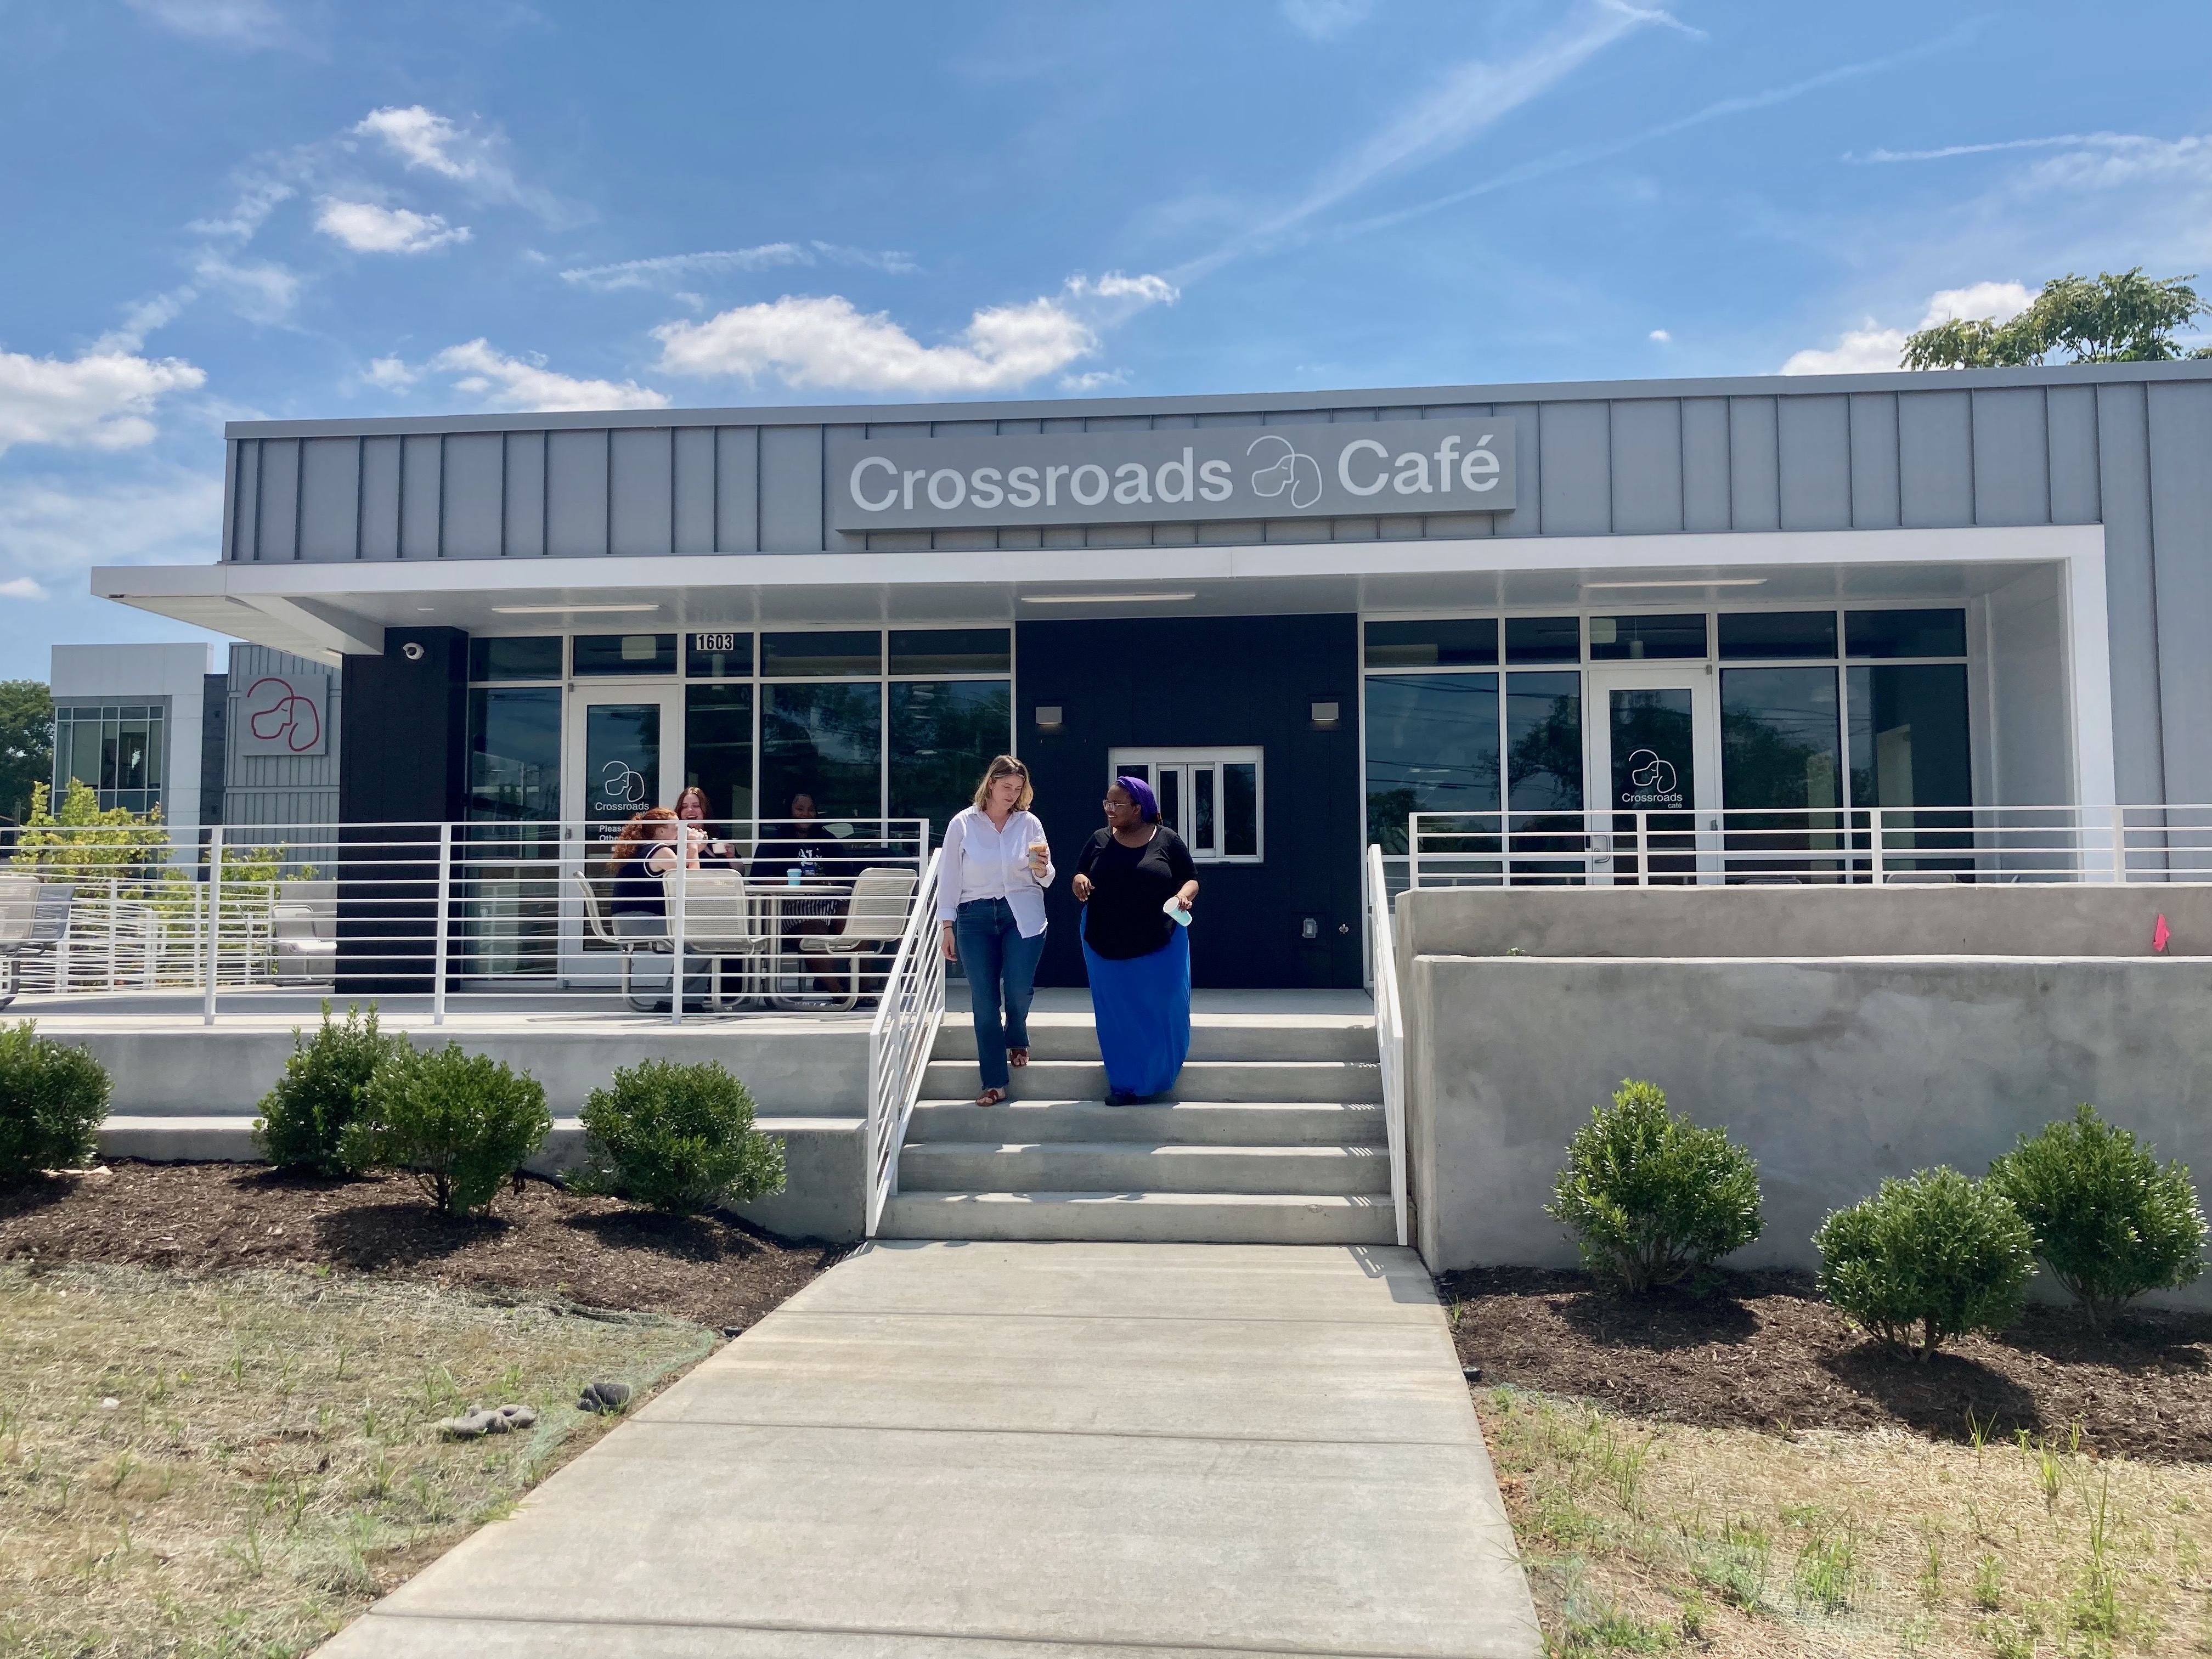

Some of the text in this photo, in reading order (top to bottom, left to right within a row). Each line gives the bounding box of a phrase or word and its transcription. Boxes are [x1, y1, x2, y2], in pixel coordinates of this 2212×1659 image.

[850, 434, 1500, 511] Crossroads Café
[699, 635, 732, 650] 1603
[1622, 792, 1683, 802] Crossroads
[595, 802, 650, 811] Crossroads
